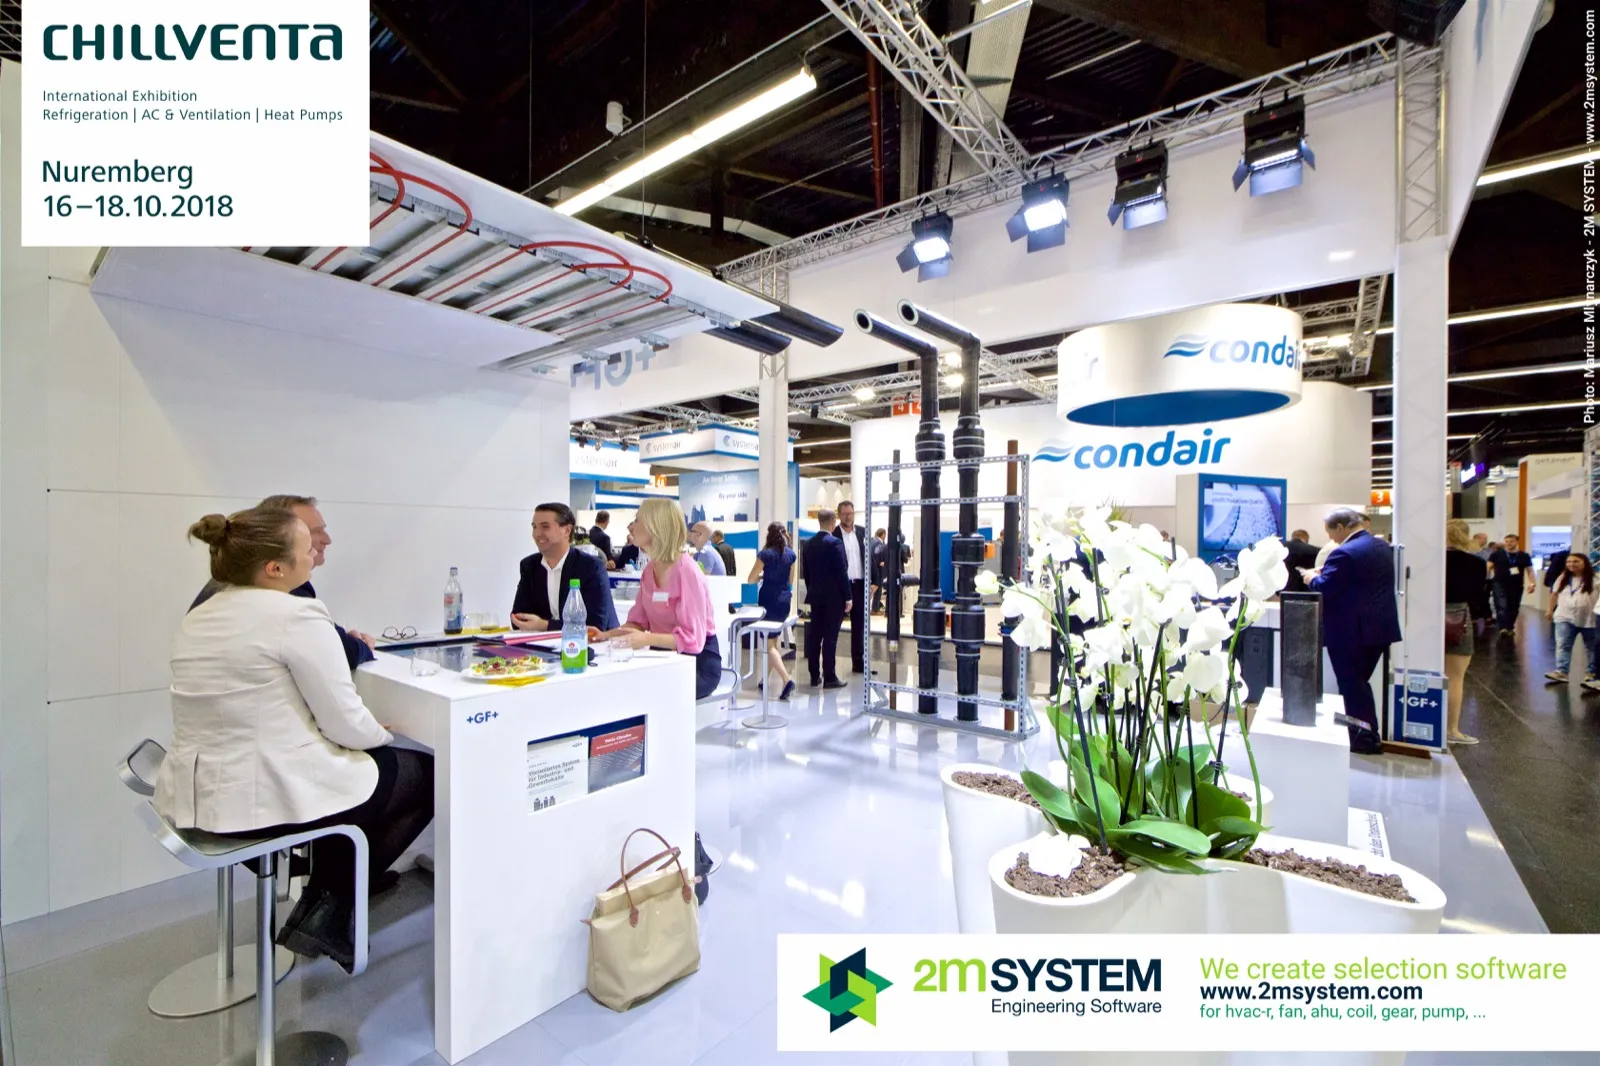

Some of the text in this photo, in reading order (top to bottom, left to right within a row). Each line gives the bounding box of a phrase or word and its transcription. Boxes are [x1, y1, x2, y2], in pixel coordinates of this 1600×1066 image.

[653, 440, 681, 453] systemair
[1074, 428, 1231, 470] condair
[1375, 490, 1384, 503] 3
[466, 710, 499, 724] +GF+
